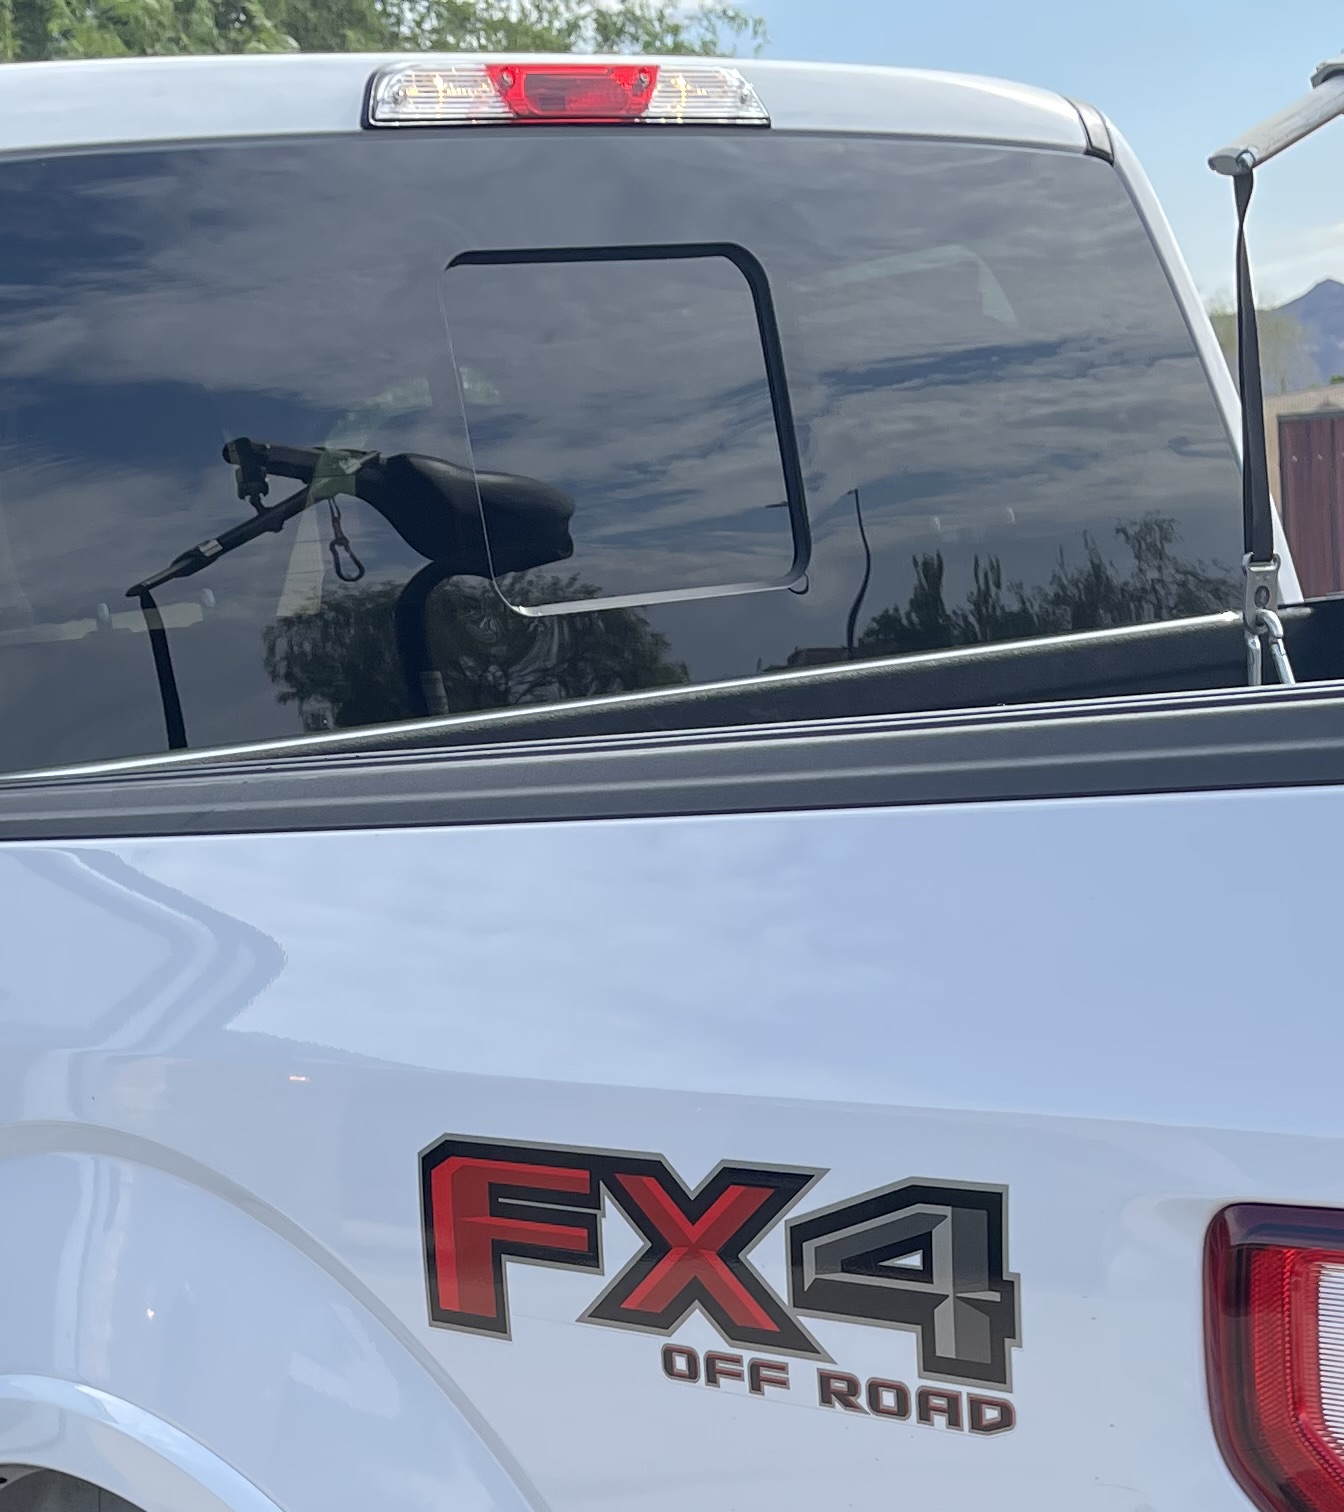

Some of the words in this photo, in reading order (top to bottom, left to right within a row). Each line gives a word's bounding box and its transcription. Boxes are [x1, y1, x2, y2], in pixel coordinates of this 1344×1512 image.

[417, 1132, 1022, 1392] FX4
[660, 1343, 791, 1396] OFF
[817, 1367, 1017, 1436] ROAD
